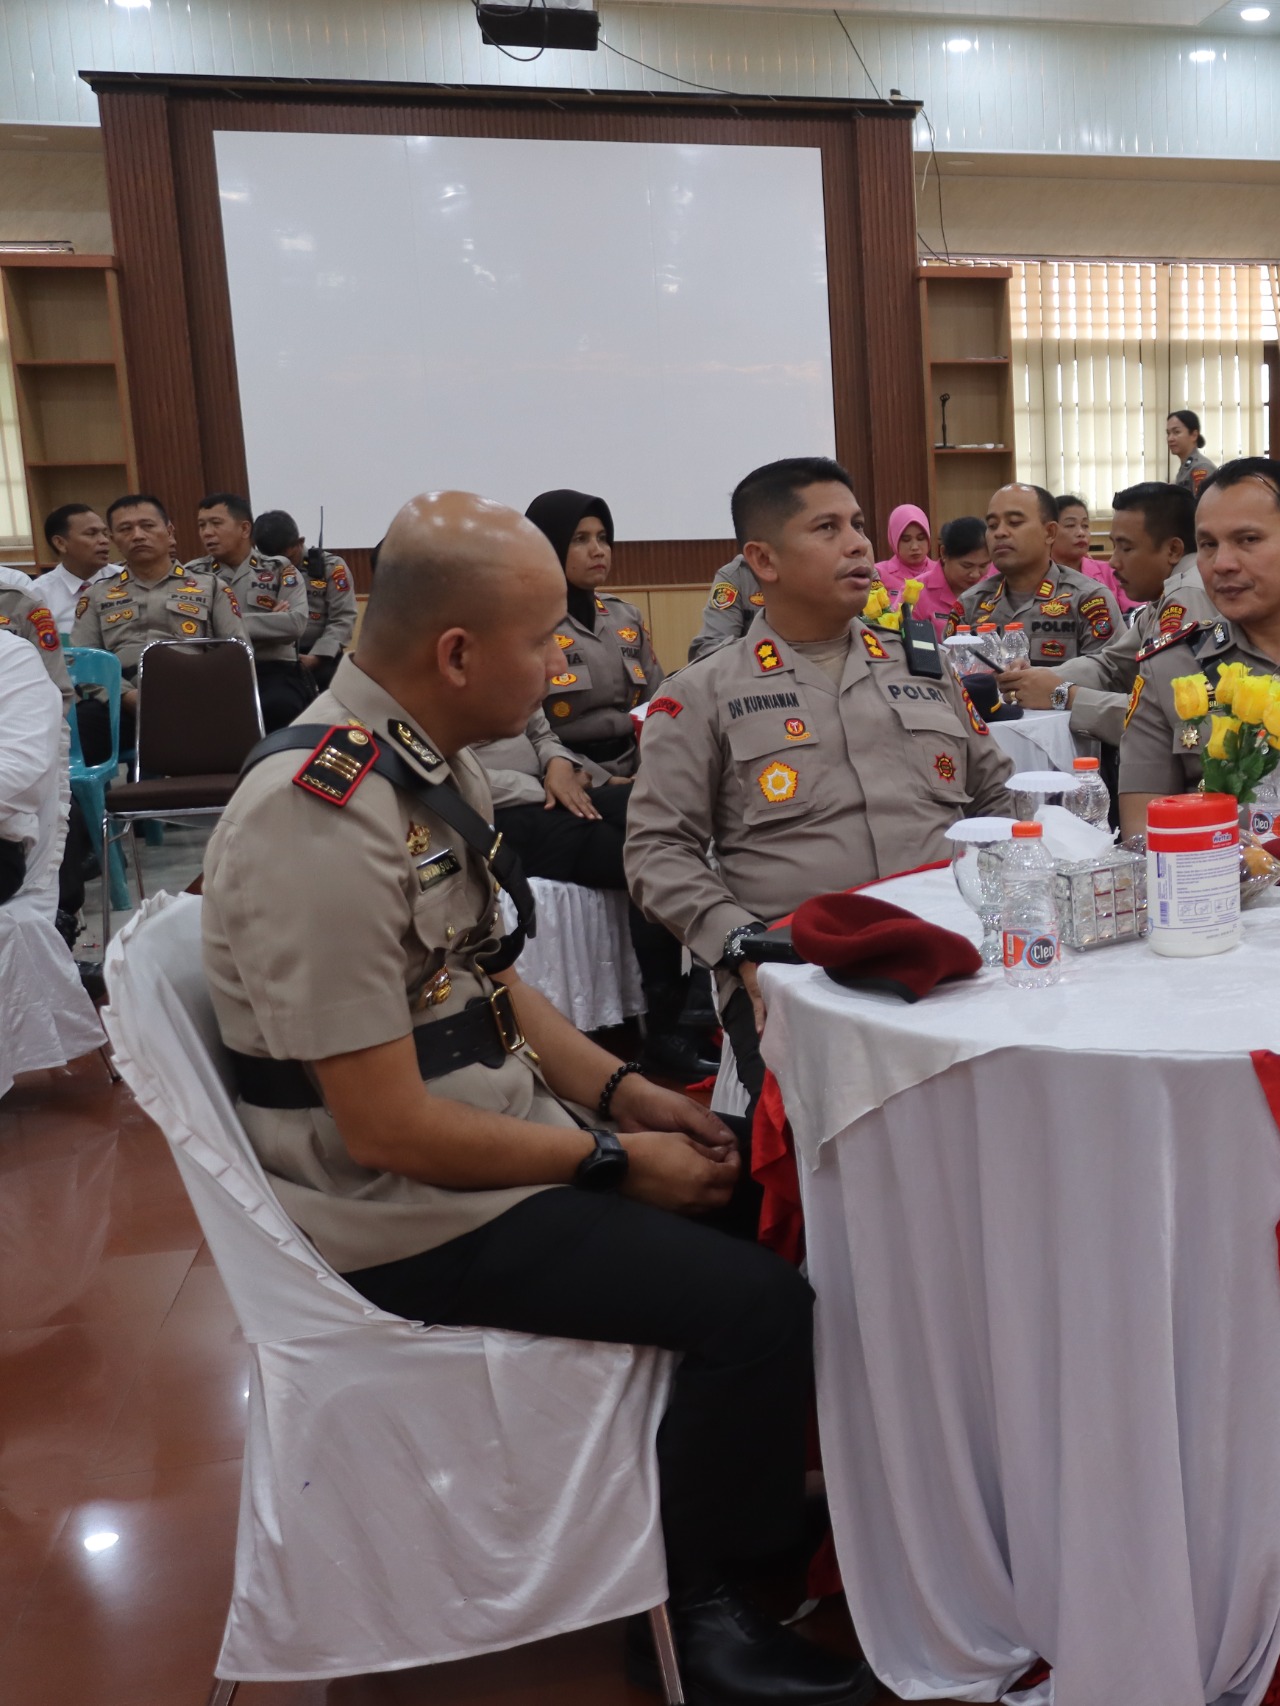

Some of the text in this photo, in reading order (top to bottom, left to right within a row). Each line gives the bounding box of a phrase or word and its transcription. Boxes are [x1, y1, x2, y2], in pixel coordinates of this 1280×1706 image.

[171, 593, 207, 603] POLRI
[1031, 621, 1075, 633] POLRI
[887, 684, 948, 704] POLRI
[728, 692, 800, 719] DN KURNIAWAN
[423, 859, 454, 881] SYAMSUL
[1034, 945, 1054, 960] Cleo
